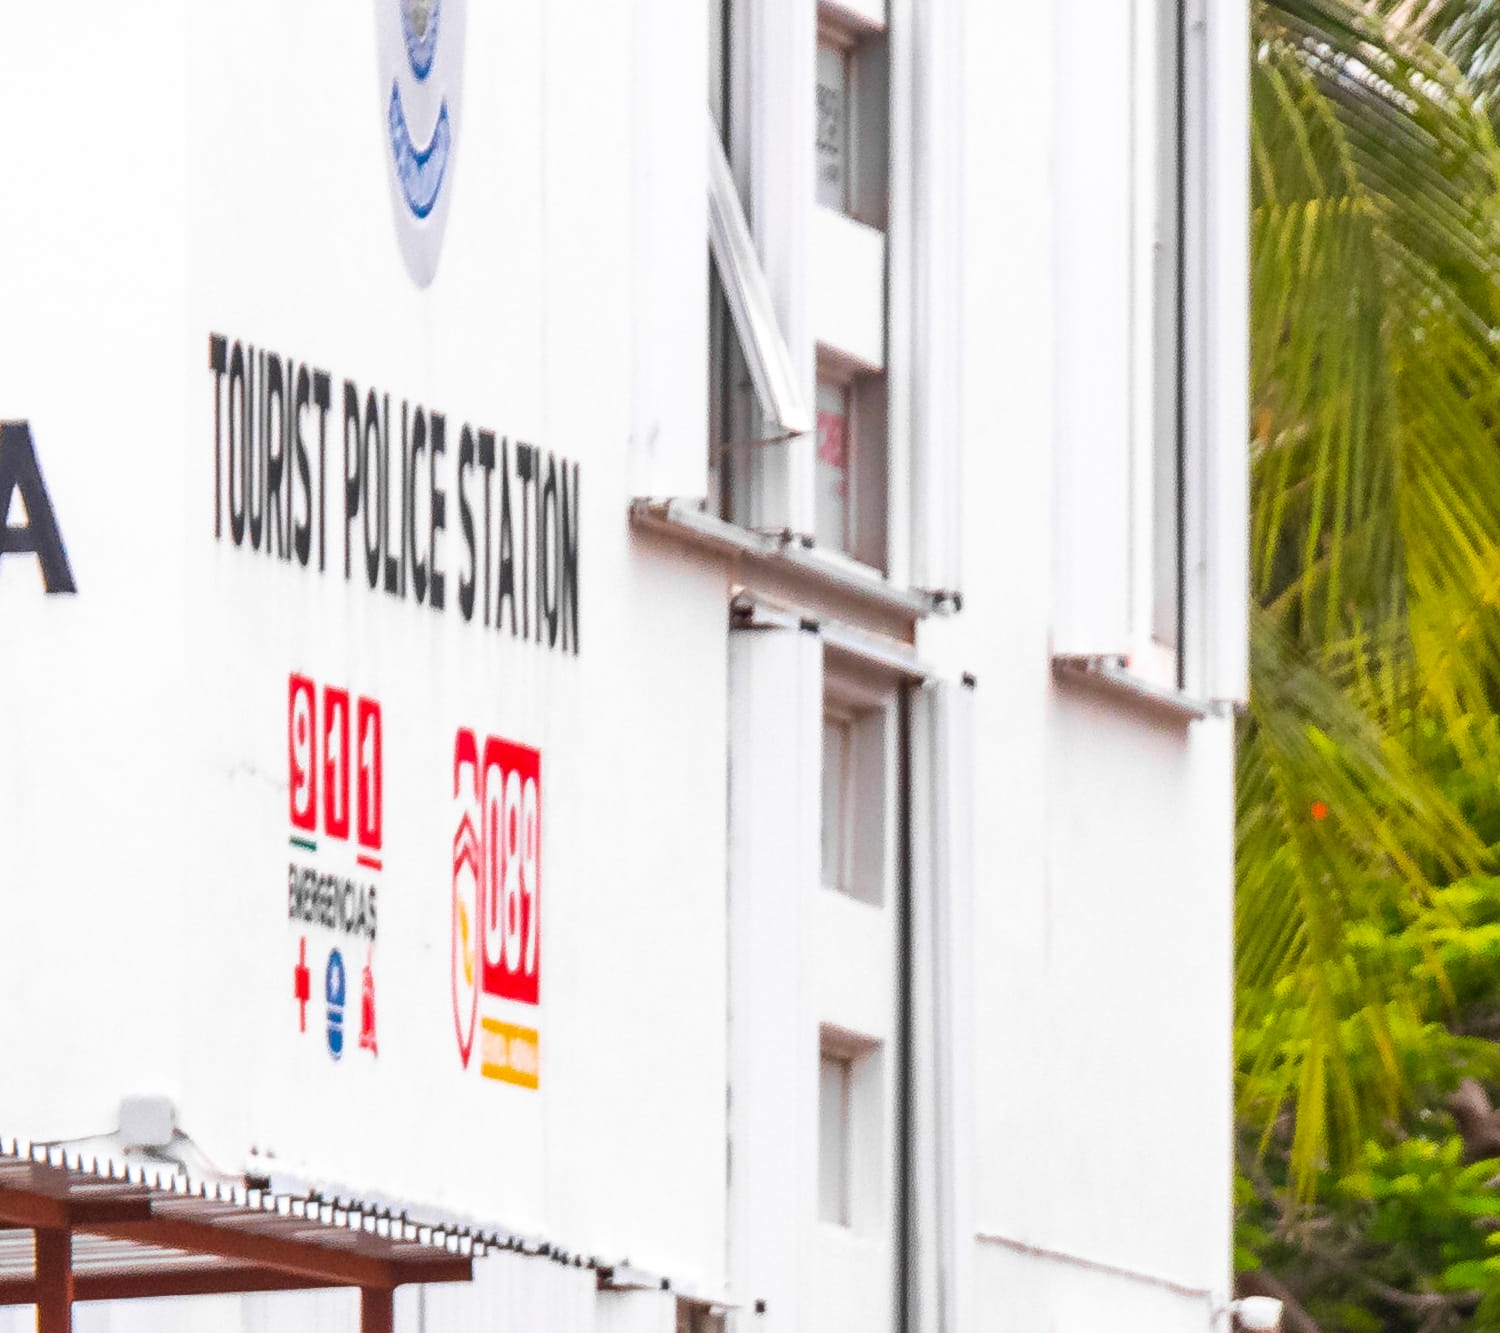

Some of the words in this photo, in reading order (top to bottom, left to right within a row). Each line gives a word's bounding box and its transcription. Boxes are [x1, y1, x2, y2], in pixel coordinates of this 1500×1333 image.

[209, 333, 331, 574] TOURIST
[343, 380, 446, 611] POLICE
[457, 422, 579, 657] STATION
[293, 684, 377, 839] 911
[486, 762, 539, 976] 089
